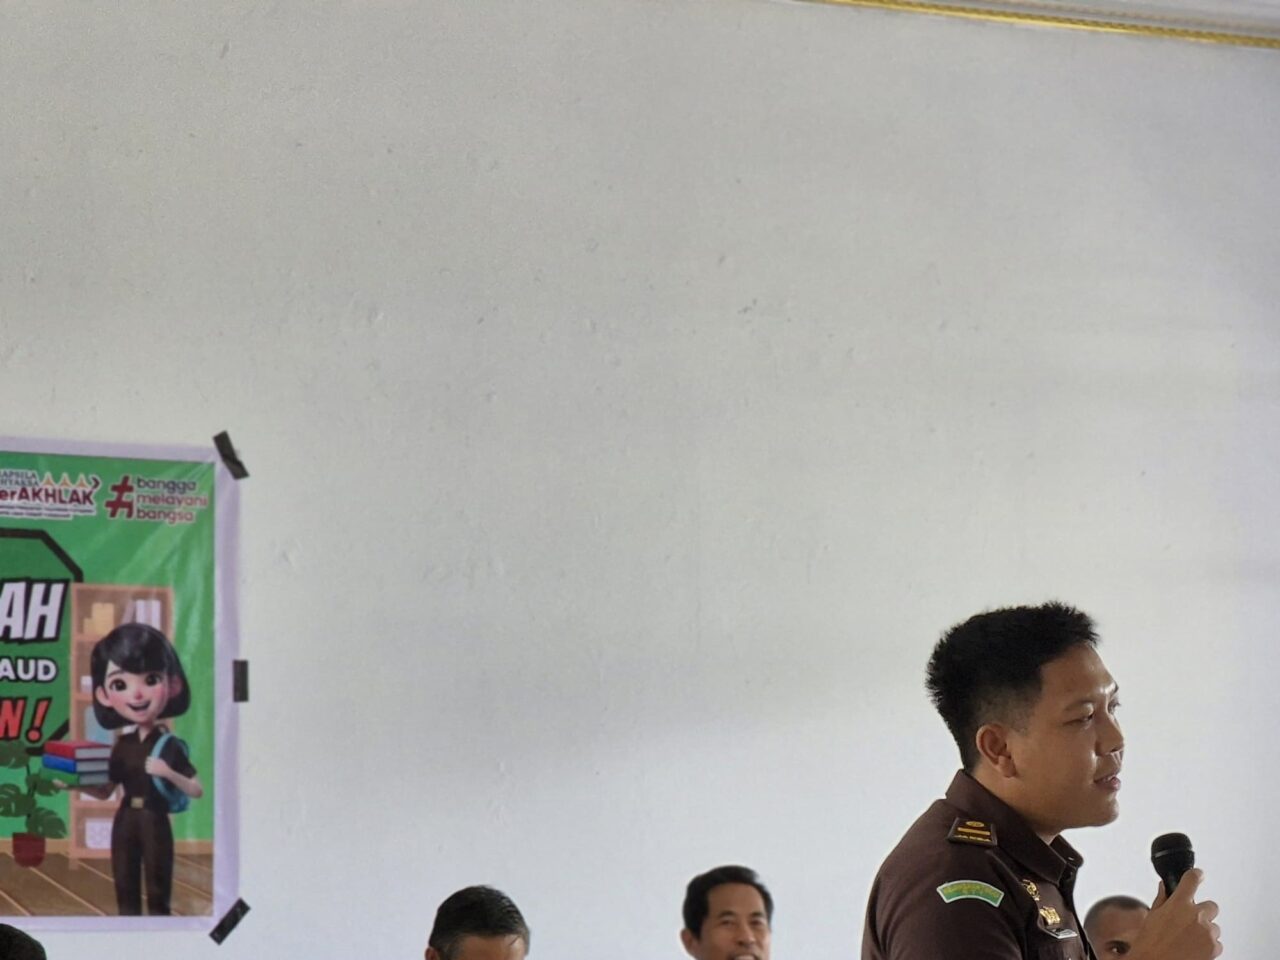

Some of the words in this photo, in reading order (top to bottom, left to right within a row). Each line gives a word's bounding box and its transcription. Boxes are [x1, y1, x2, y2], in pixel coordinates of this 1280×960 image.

[137, 477, 196, 493] bangga
[137, 492, 207, 506] melayani
[137, 508, 193, 523] bangsa
